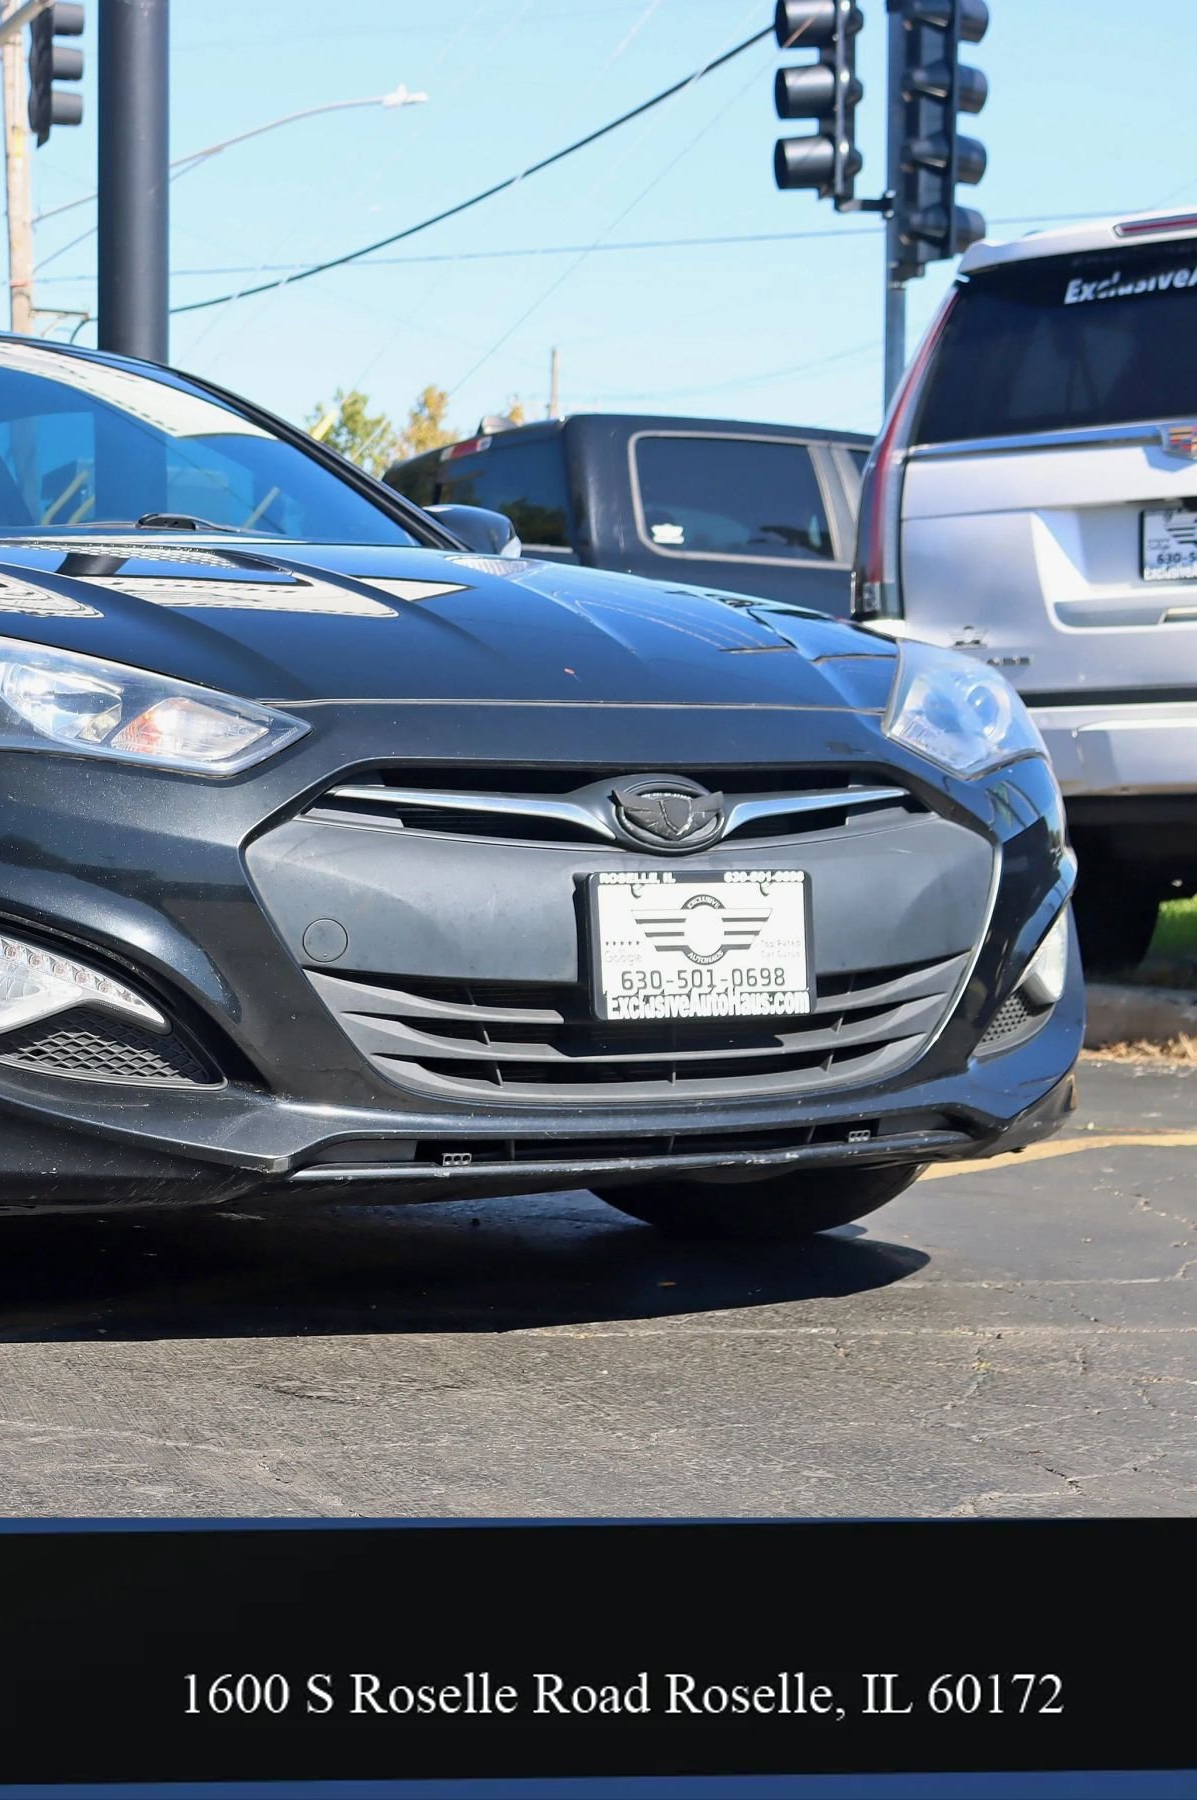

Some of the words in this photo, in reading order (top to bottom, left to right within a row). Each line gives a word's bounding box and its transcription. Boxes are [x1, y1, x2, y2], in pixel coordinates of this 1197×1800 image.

[687, 950, 724, 964] AUTOHAUS
[621, 967, 786, 991] 630-501-0698
[606, 987, 811, 1020] ExclusiveAutoHaus.com
